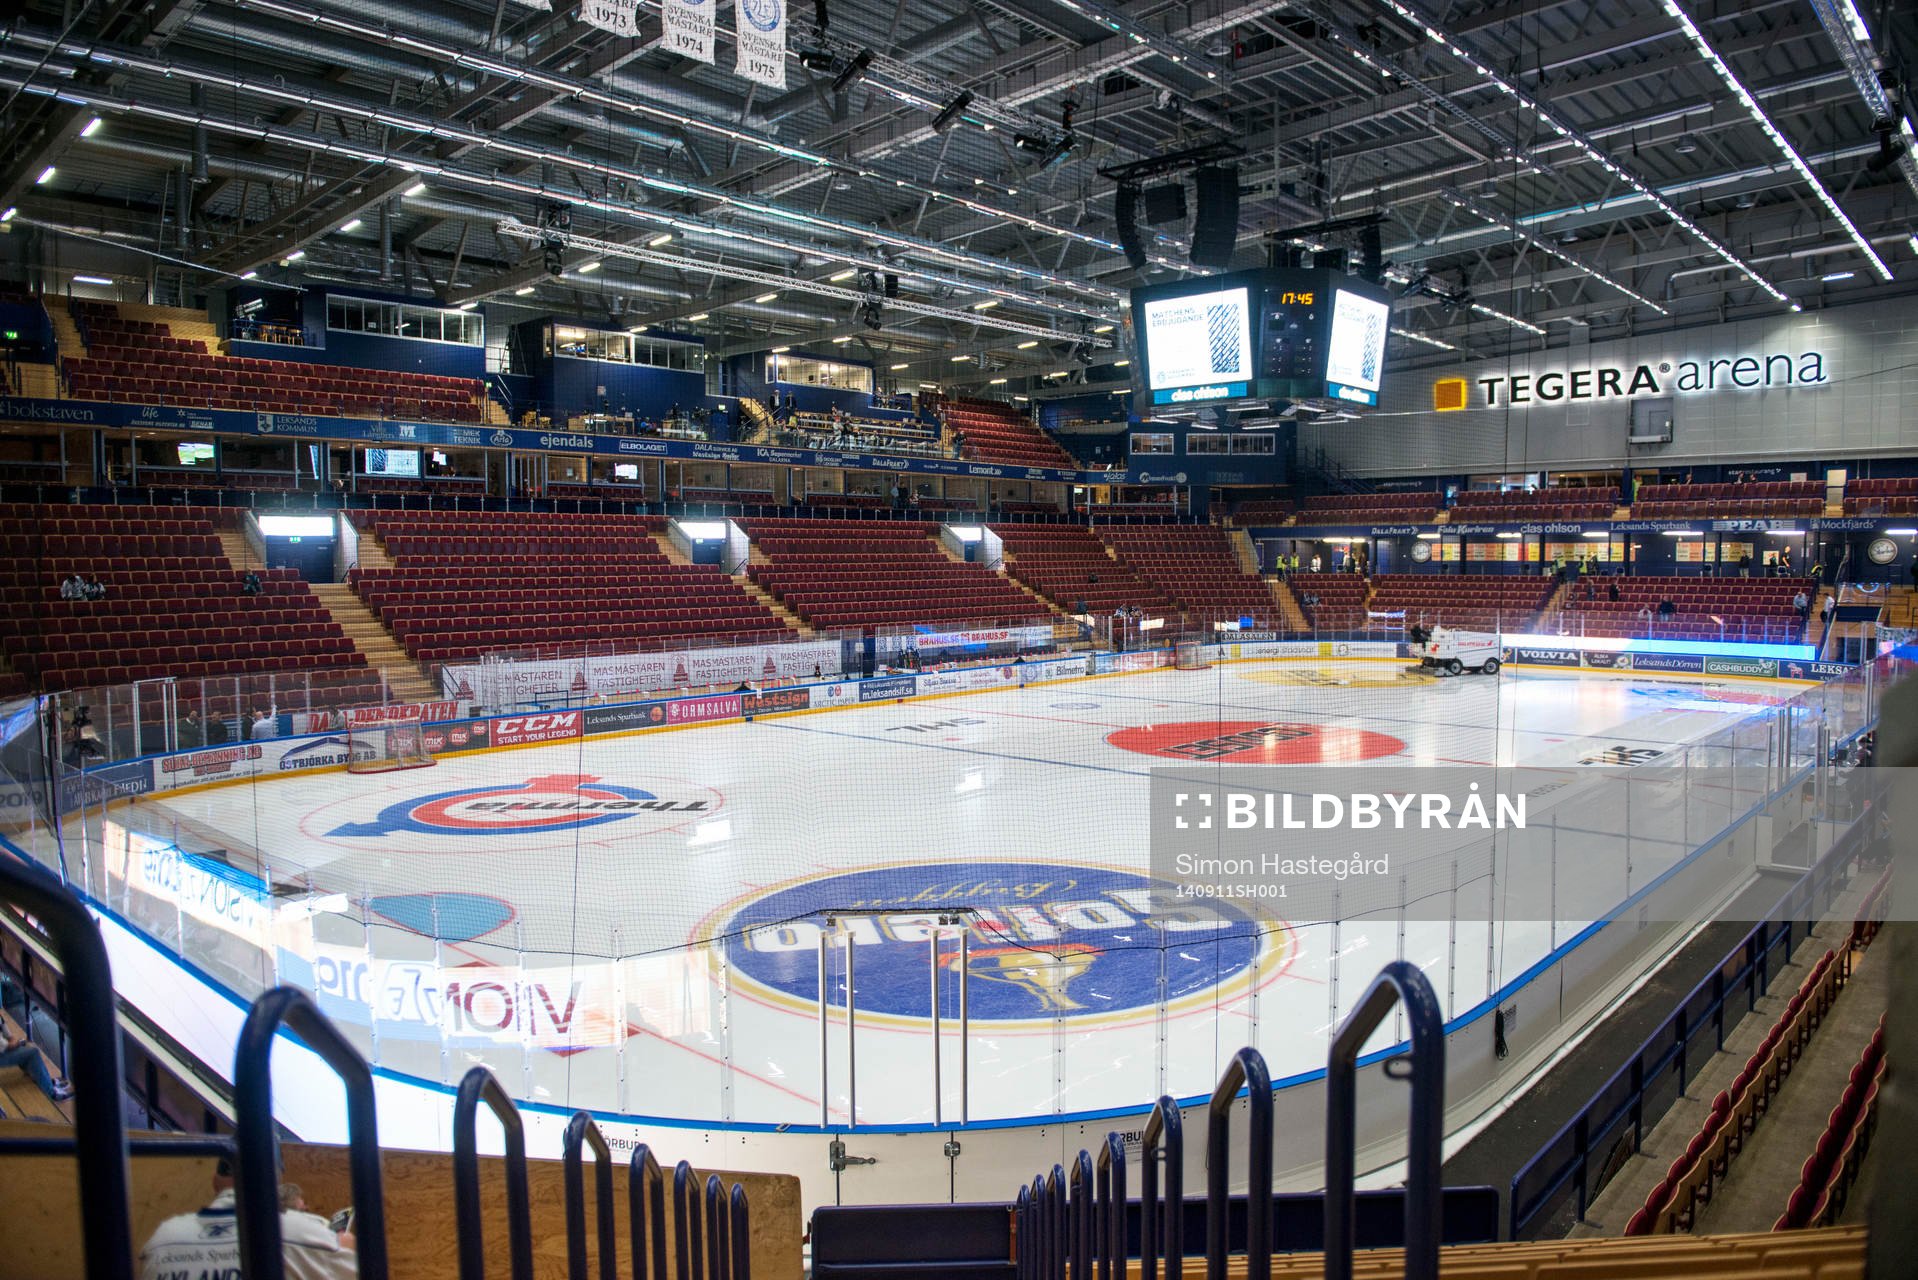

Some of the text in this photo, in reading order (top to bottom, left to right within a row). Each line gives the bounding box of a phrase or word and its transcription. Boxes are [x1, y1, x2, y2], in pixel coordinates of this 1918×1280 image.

[595, 7, 627, 29] 1973
[668, 5, 712, 27] SVENSKA
[667, 14, 713, 38] MÄSTARE
[676, 33, 704, 54] 1974
[742, 31, 782, 53] SVENSKA
[742, 41, 784, 63] MÄSTARE
[749, 59, 775, 79] 1975
[1281, 292, 1314, 305] 17:45
[1678, 351, 1828, 391] arena
[7, 401, 94, 421] bokstaven
[276, 416, 317, 425] LEKSANDS
[276, 424, 317, 433] KOMMUN
[453, 436, 481, 444] TEKNIK
[540, 433, 594, 450] ejendals
[620, 442, 666, 452] ELBOLAGET
[757, 448, 769, 458] ICA
[968, 464, 994, 475] Lemont
[1521, 522, 1581, 533] clas ohlson
[1610, 521, 1691, 531] Leksands Sparbank
[1724, 520, 1783, 531] PEAB
[1520, 650, 1578, 660] VOLVIA
[695, 666, 754, 679] FASTIGHETER
[1056, 665, 1085, 676] Bilmetro
[597, 675, 662, 689] FASTIGHETER
[744, 691, 809, 709] Westsign
[682, 700, 738, 718] ORMSALVA
[497, 713, 577, 734] CCM
[587, 711, 646, 725] Leksands Sparbank
[498, 728, 577, 745] START YOUR LEGEND
[279, 755, 334, 770] ÖSTBJÖRKA
[363, 750, 376, 760] AB
[465, 801, 709, 813] Thermia
